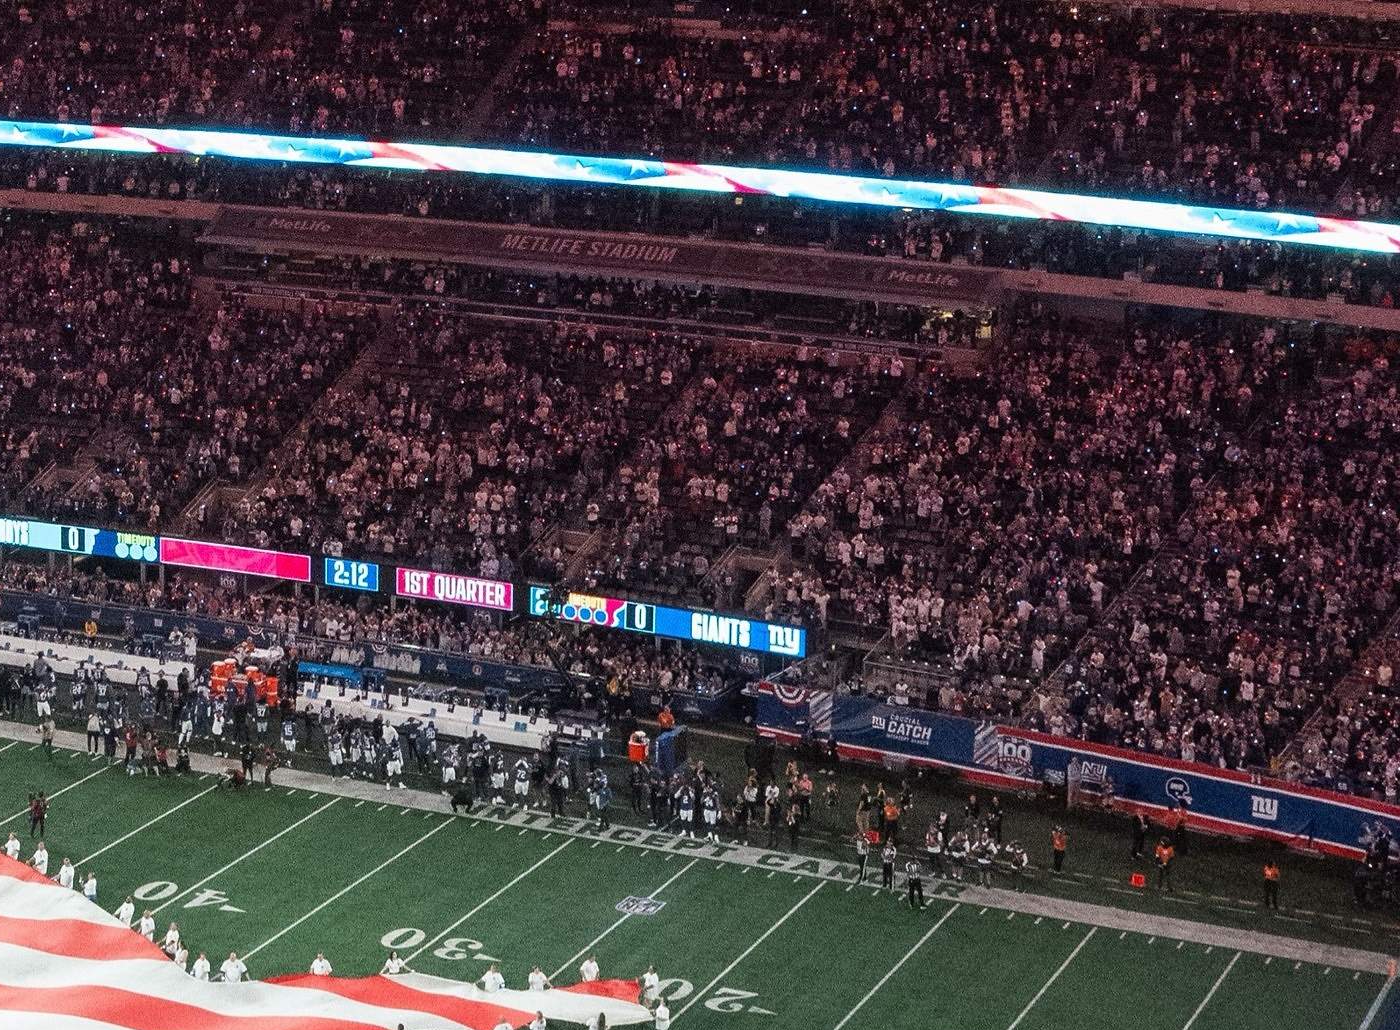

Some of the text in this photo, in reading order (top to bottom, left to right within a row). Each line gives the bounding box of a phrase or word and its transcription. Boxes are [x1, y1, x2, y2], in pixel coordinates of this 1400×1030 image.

[268, 216, 332, 234] MetLife
[500, 233, 678, 263] METLIFE STADIUM
[887, 269, 959, 287] MetLife
[68, 526, 79, 550] 0
[333, 559, 370, 588] 2:12
[403, 570, 432, 596] 1ST
[433, 574, 507, 607] QUARTER
[635, 602, 647, 630] 0
[690, 612, 751, 648] GIANTS
[886, 720, 932, 741] CATCH
[889, 713, 921, 726] CRUCIAL
[995, 742, 1026, 762] 100
[468, 806, 738, 860] INTERCEPT
